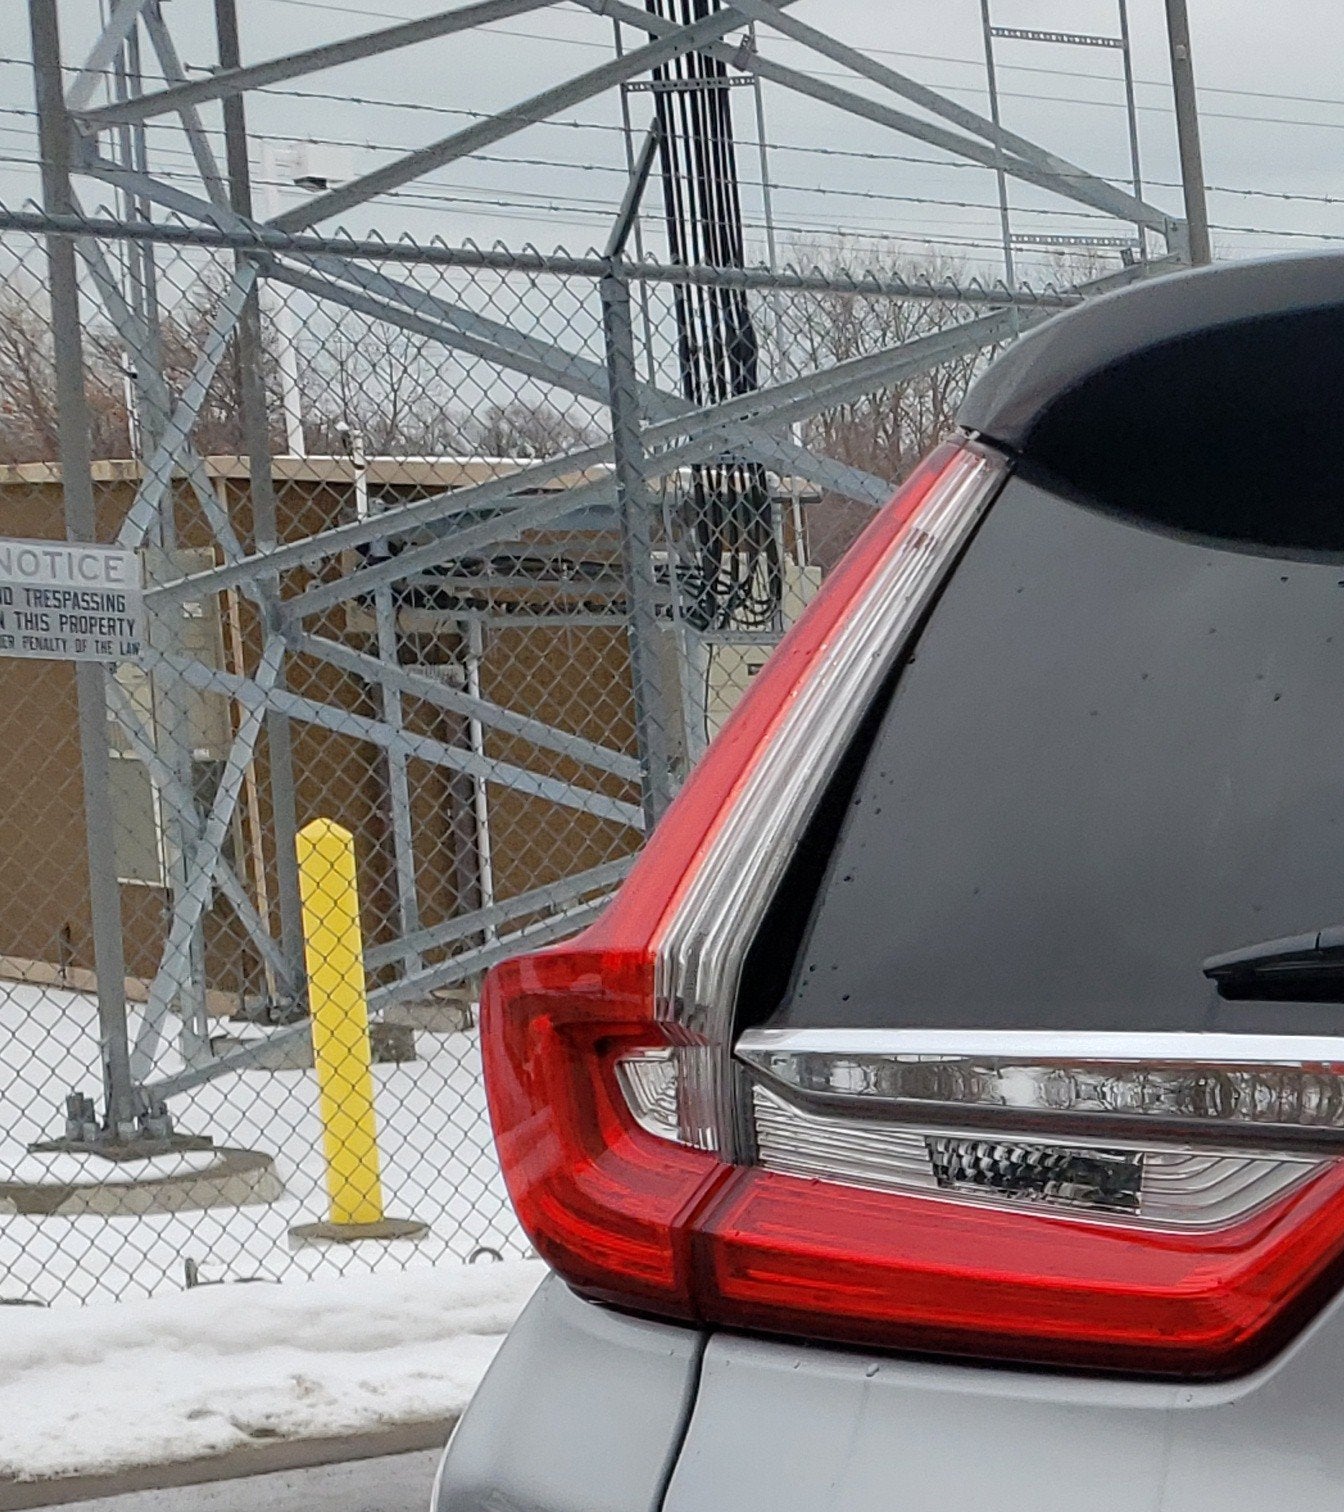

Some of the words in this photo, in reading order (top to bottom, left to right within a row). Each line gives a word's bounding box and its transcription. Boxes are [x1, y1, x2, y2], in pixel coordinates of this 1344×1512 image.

[0, 547, 124, 582] NOTICE
[22, 587, 126, 613] TRESPASSING
[14, 610, 50, 632] THIS
[59, 613, 136, 637] PROPERTY
[22, 635, 67, 654] PENALTY
[75, 638, 87, 653] OF
[95, 640, 113, 655] THE
[120, 641, 140, 655] LAW
